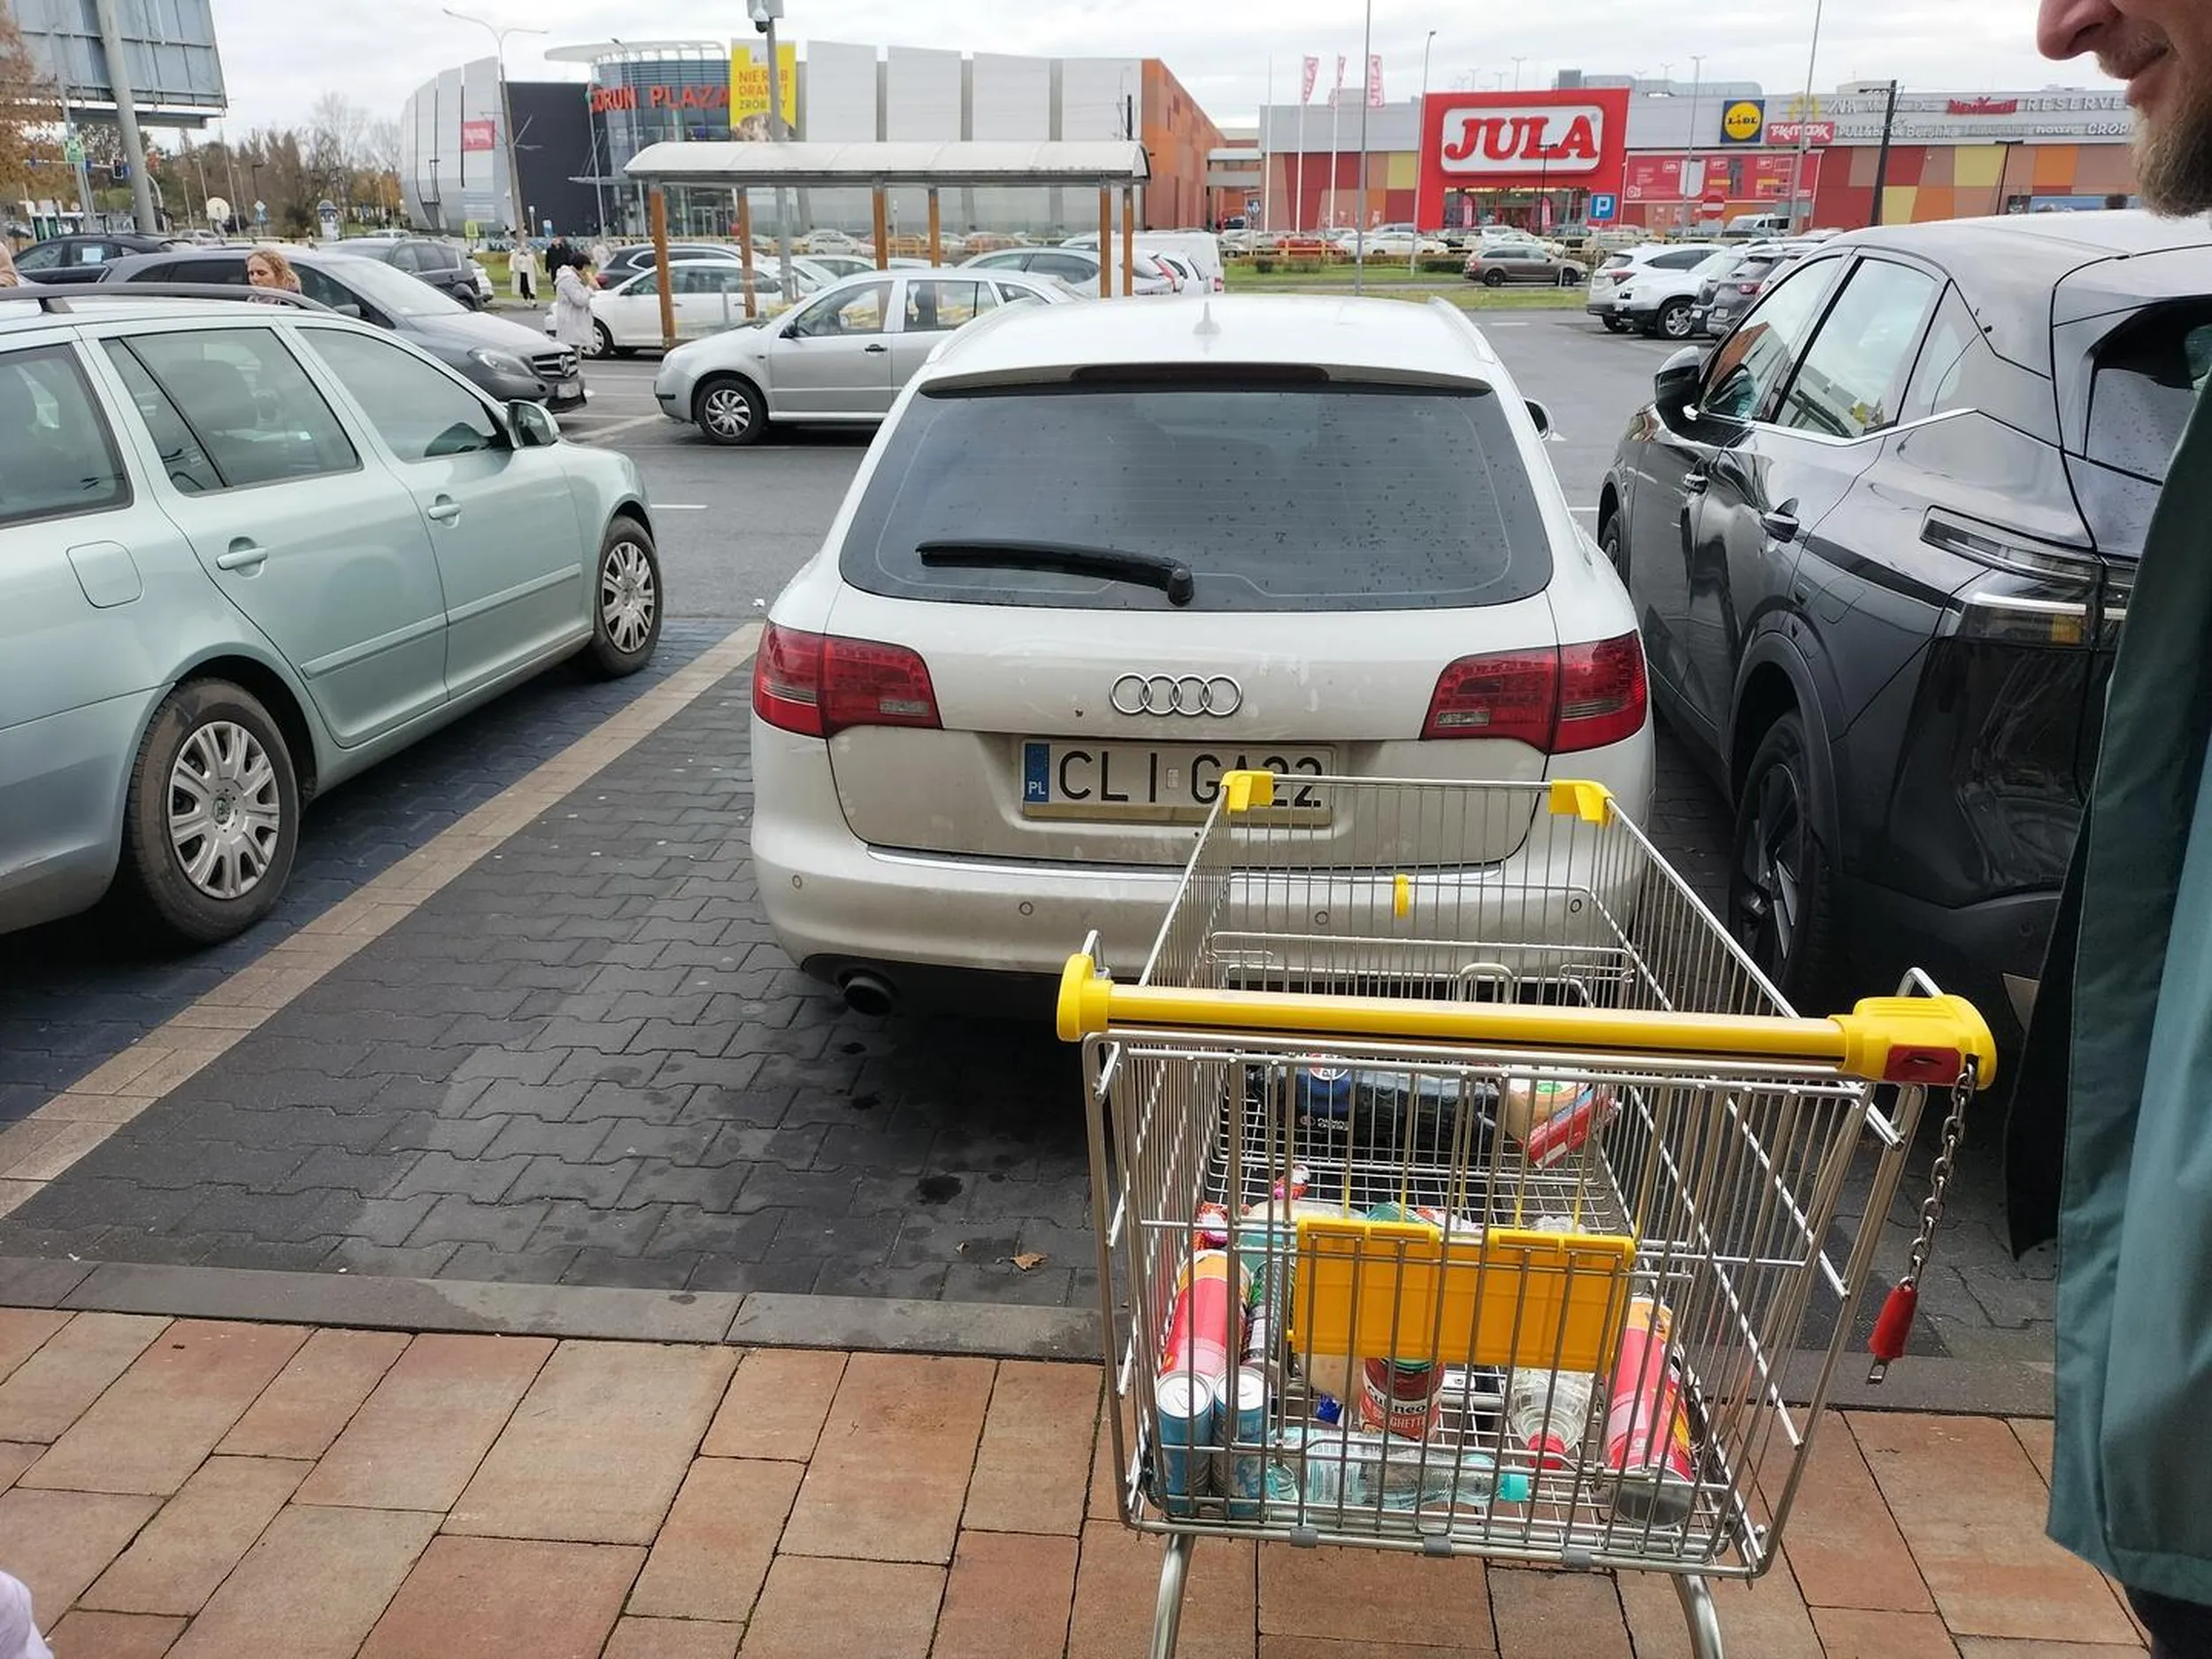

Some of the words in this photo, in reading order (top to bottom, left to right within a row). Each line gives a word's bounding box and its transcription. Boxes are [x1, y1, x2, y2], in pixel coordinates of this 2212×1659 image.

[2026, 96, 2125, 112] RESERVE
[1444, 114, 1598, 161] JULA
[1595, 196, 1611, 218] P
[1028, 781, 1046, 795] PL
